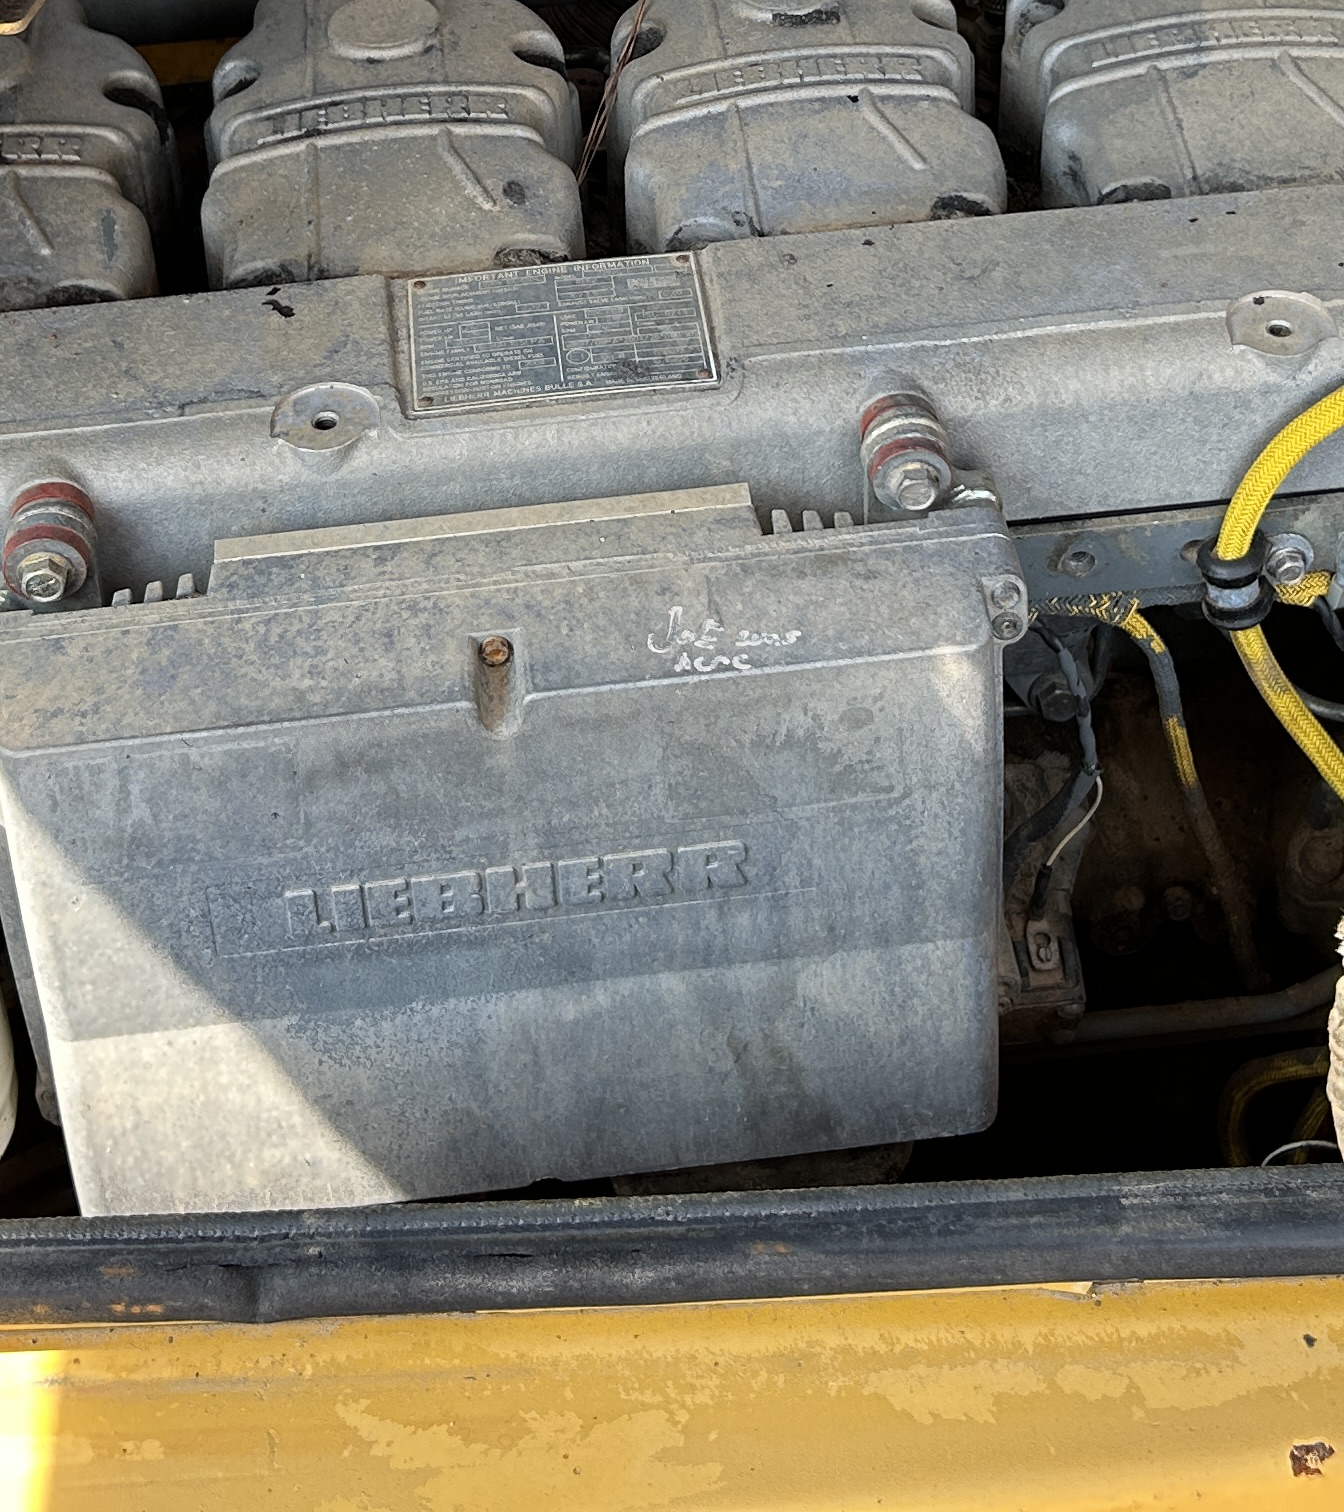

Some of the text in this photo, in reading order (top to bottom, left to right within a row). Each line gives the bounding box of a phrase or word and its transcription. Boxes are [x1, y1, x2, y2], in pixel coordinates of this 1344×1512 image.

[1086, 16, 1340, 68] LIEBHERR
[674, 54, 924, 105] LIEBHERR
[256, 93, 509, 145] LIEBHERR
[455, 258, 650, 284] IMPORTANT ENGINE INFORMATION
[493, 385, 542, 397] MACHINES
[284, 840, 748, 939] LIEBHERR
